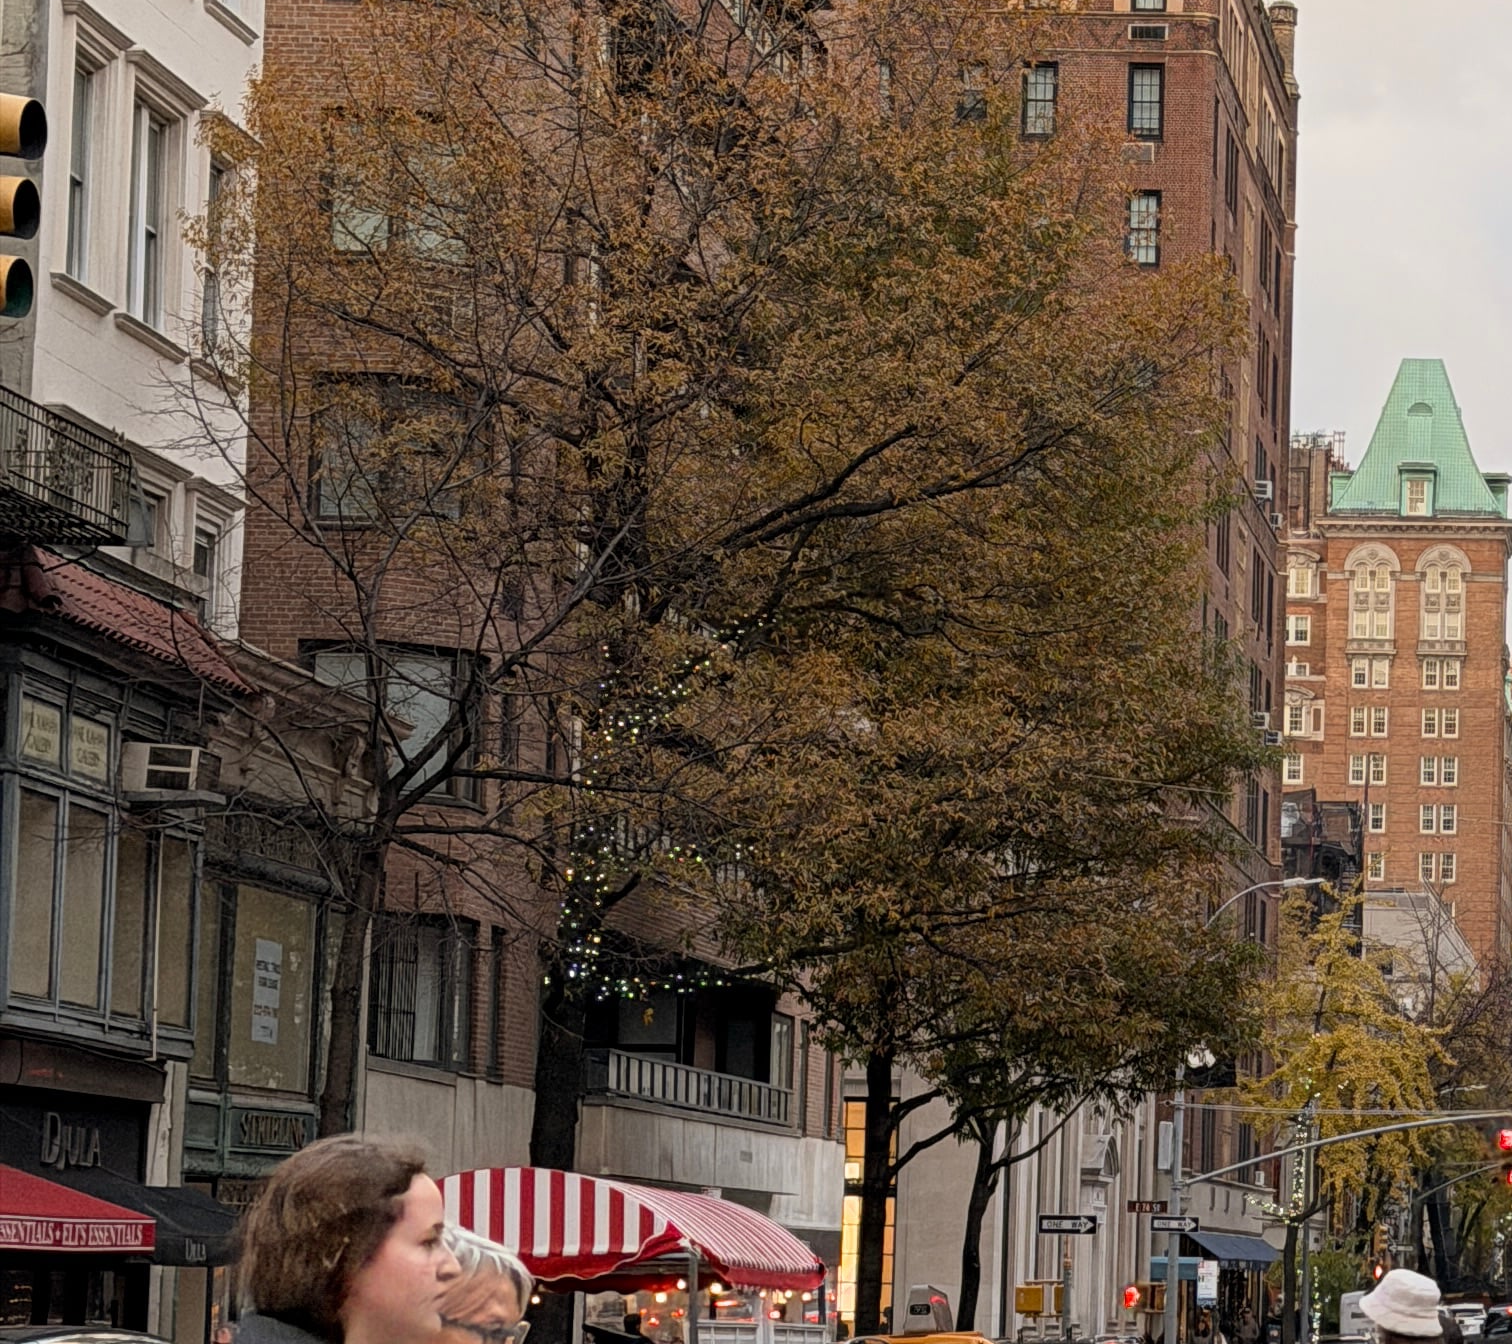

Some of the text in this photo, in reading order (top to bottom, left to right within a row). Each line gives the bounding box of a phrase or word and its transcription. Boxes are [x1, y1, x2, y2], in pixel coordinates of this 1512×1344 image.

[1046, 1221, 1089, 1229] ONE WAY
[1156, 1220, 1193, 1229] ONE WAY
[0, 1220, 143, 1246] SSENTIALS ELI'S ESSENTIALS
